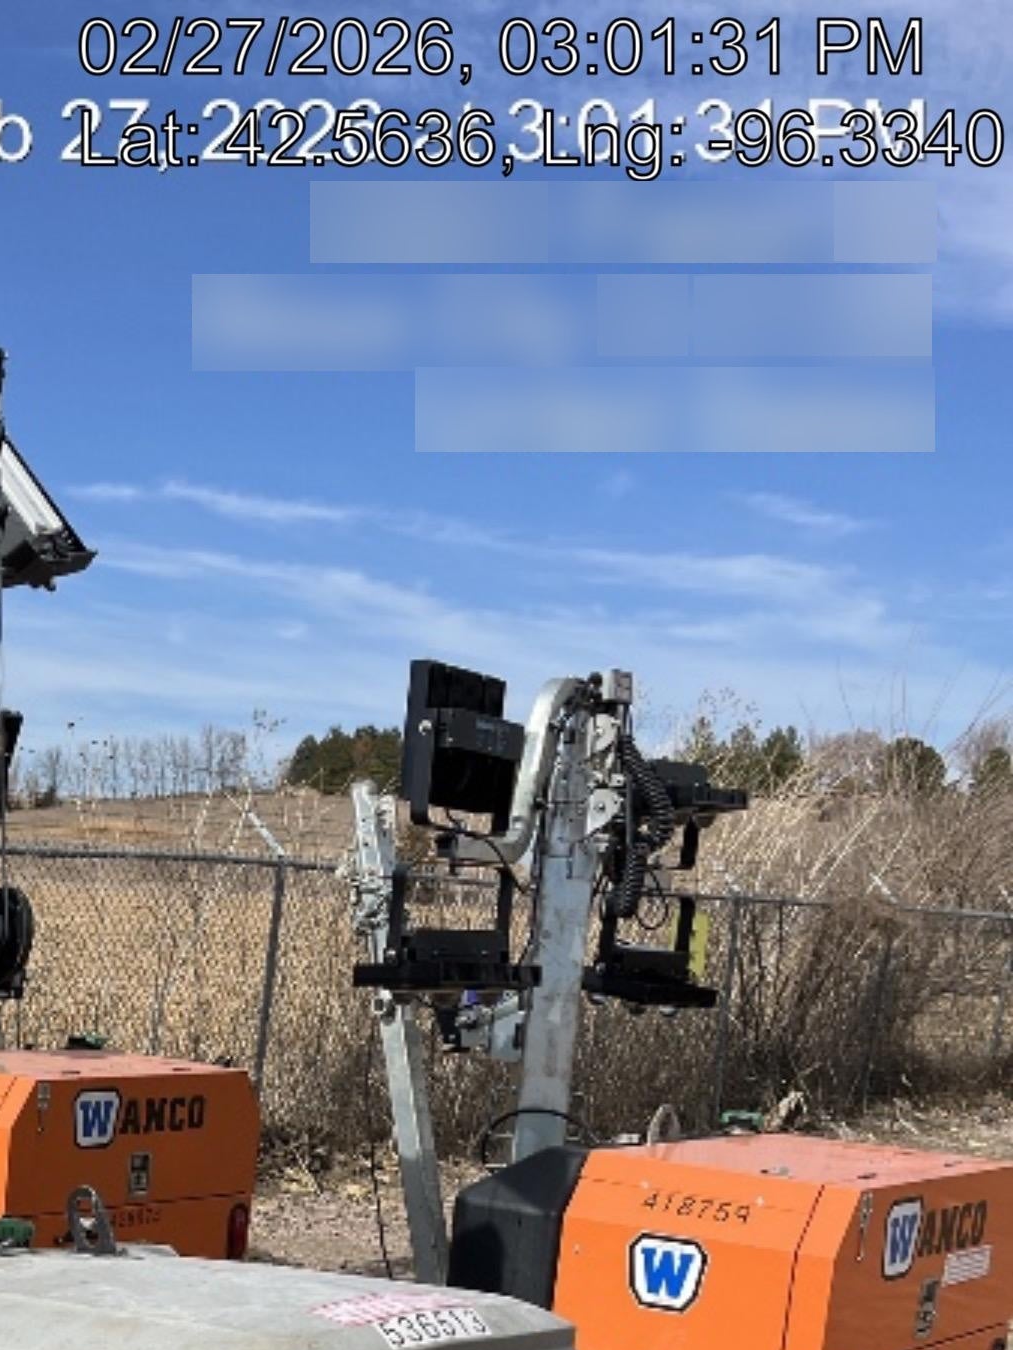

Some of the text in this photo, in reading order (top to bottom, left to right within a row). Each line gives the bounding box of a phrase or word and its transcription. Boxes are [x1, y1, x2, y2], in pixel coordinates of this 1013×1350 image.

[78, 1094, 206, 1142] WANCO
[889, 1199, 988, 1266] WANCO
[640, 1247, 696, 1300] W
[378, 1308, 488, 1347] 536513
